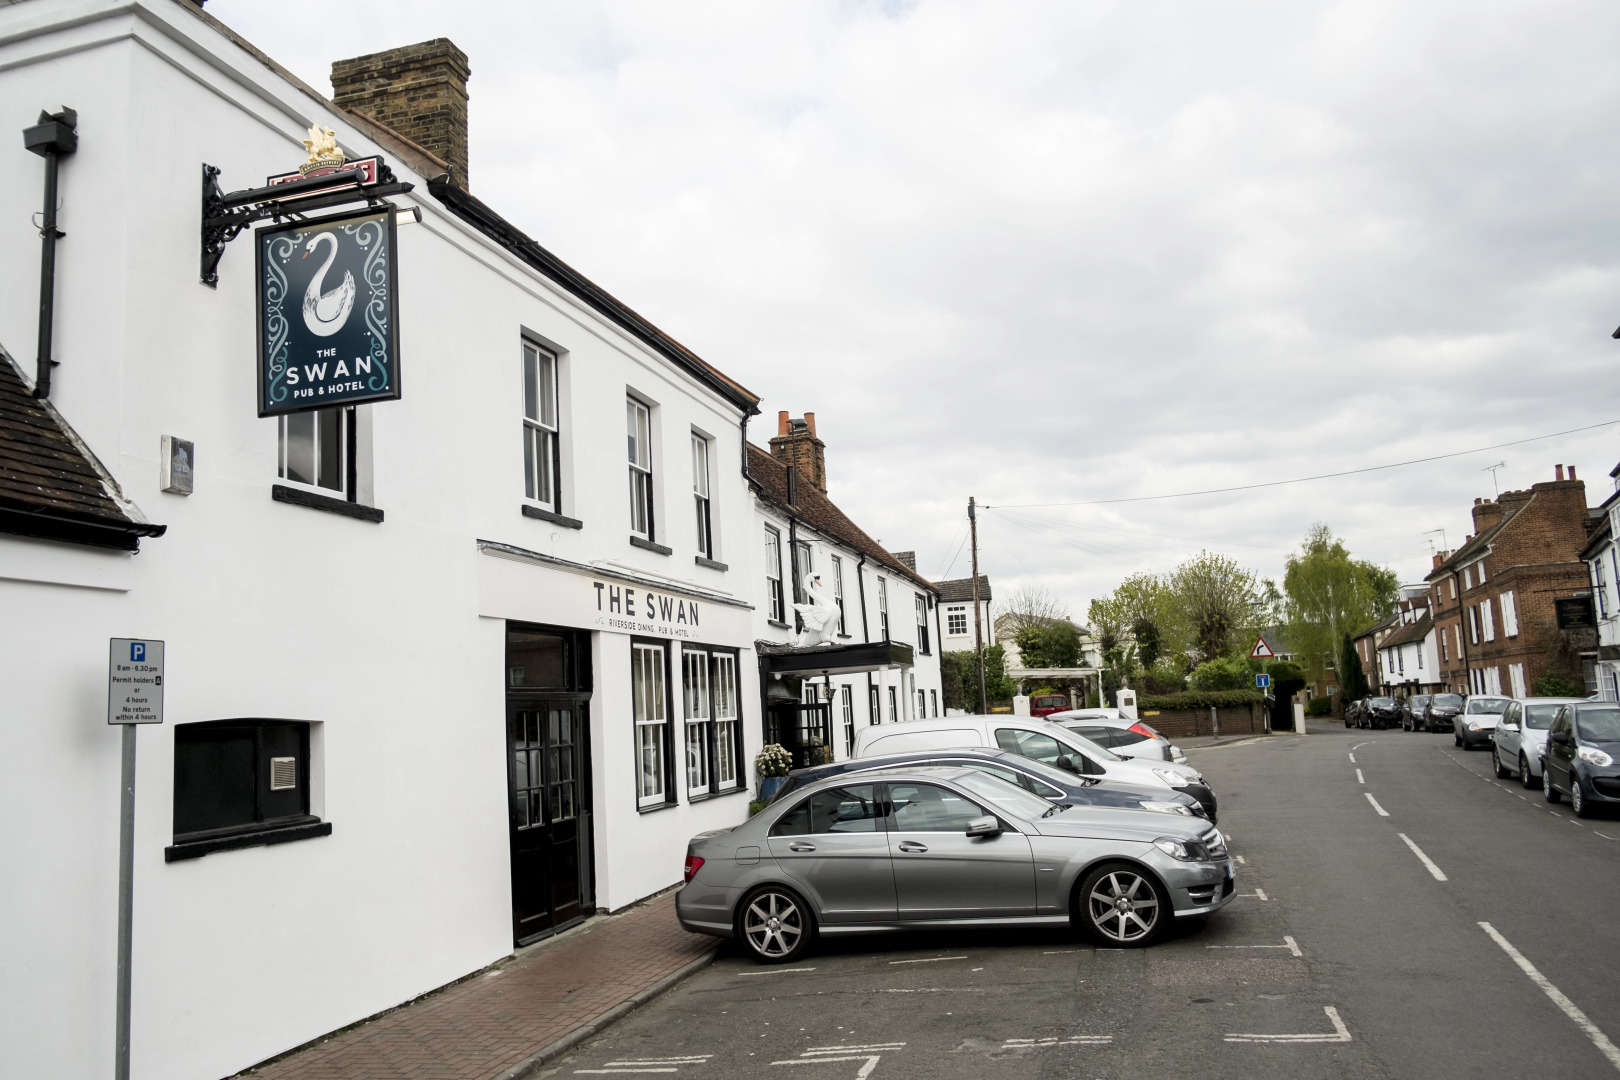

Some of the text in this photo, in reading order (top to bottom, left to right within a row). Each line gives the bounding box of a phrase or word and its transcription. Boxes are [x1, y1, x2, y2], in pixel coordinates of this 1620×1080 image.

[317, 348, 336, 358] THE
[286, 355, 371, 385] SWAN
[294, 381, 365, 398] PUB & HOTEL
[593, 581, 699, 627] THE SWAN
[609, 618, 636, 630] RIVERSIDE
[658, 626, 668, 634] PUB
[674, 628, 689, 638] HOTEL
[134, 644, 144, 660] P
